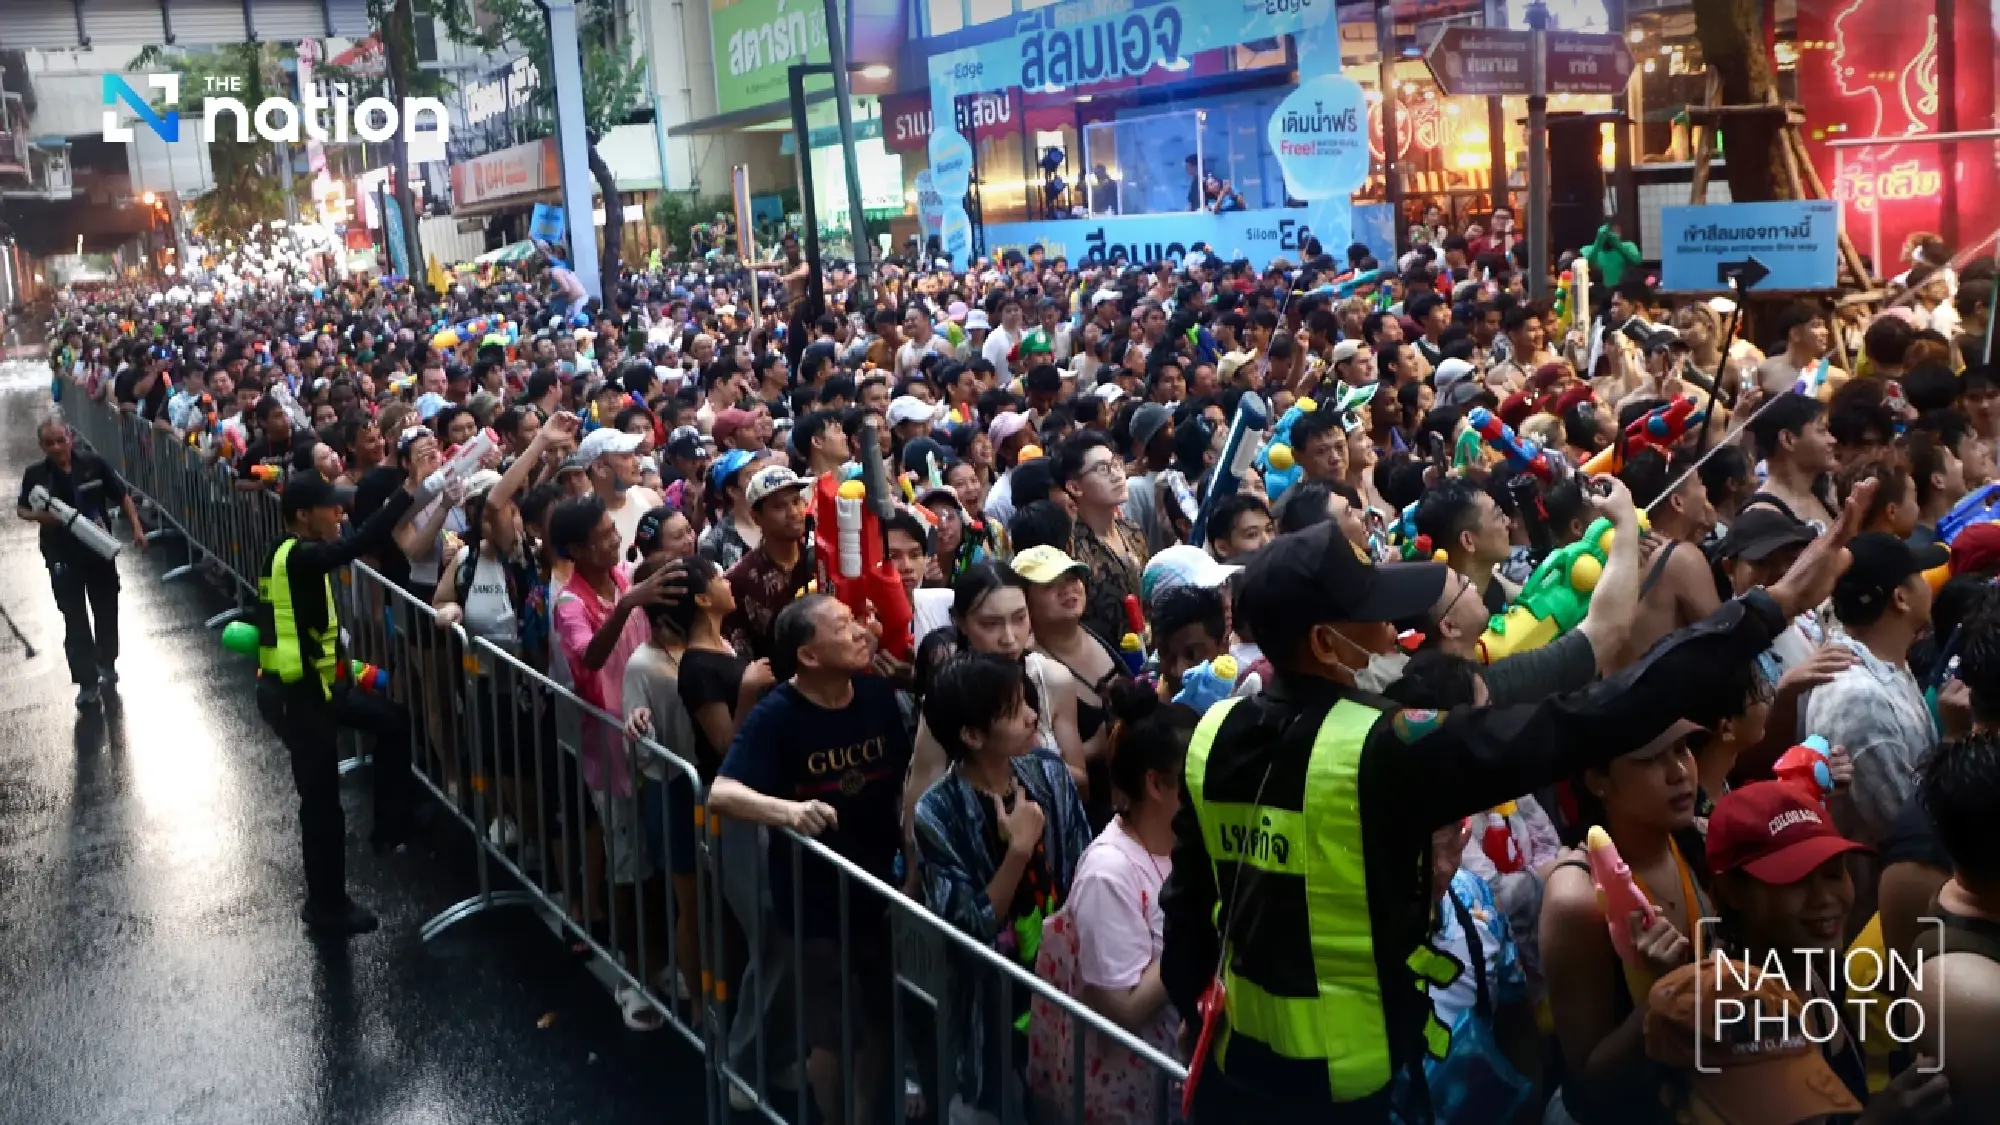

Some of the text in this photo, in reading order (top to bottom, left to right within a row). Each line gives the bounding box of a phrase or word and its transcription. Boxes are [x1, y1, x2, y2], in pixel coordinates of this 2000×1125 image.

[1014, 6, 1185, 91] สีลมเอจ
[953, 61, 984, 81] Edge
[1281, 140, 1316, 156] Free!
[1246, 228, 1278, 241] Silom
[808, 736, 883, 774] GUCCI
[1220, 815, 1289, 865] เทศกิจ
